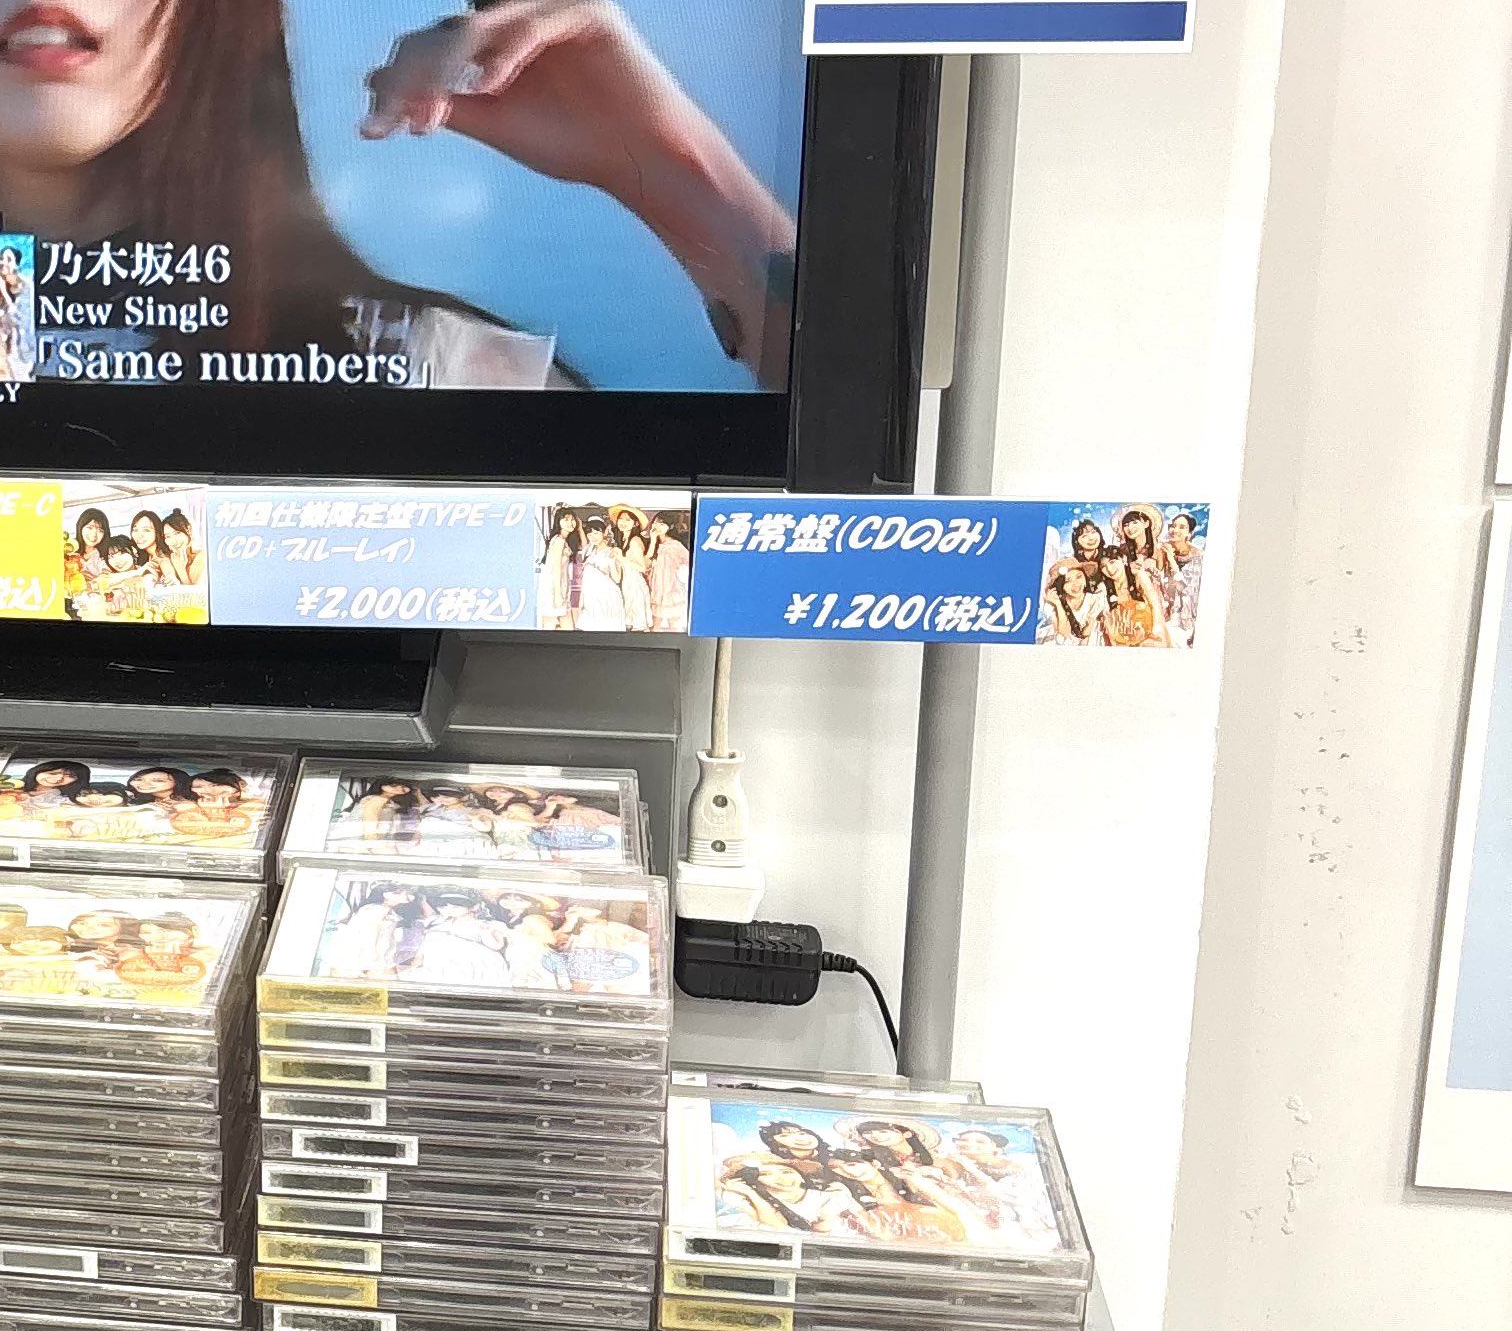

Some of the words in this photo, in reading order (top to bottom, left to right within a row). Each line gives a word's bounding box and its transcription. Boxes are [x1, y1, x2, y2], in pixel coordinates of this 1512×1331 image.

[39, 241, 231, 288] 乃木坂46
[39, 296, 109, 327] New
[123, 295, 229, 336] Single
[700, 512, 998, 557] 通常盤(CDのみ)
[783, 592, 1033, 635] ¥1,200(税込)
